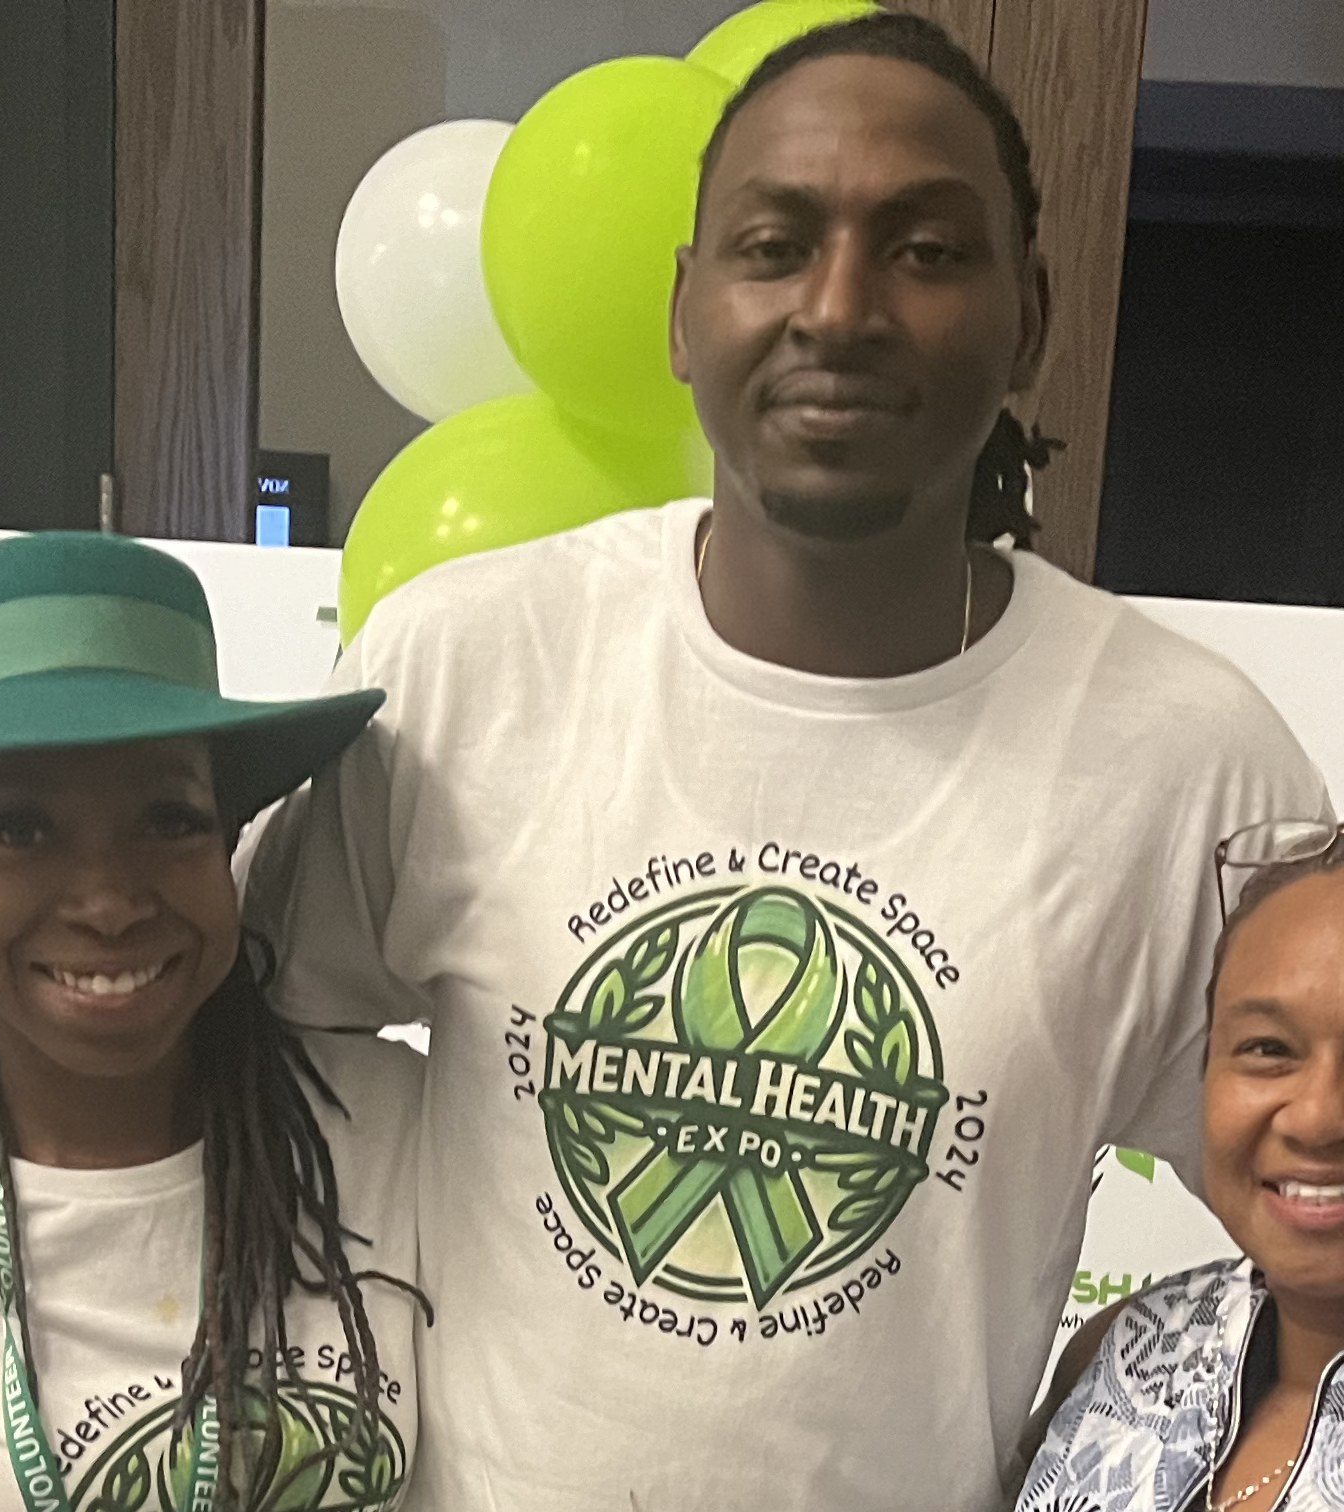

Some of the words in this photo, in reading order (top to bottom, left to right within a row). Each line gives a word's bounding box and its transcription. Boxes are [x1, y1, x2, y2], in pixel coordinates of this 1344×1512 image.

[567, 847, 716, 944] Redefine
[757, 842, 880, 904] Create
[881, 893, 960, 990] Space
[505, 1004, 537, 1100] 2024
[549, 1036, 743, 1109] MENTAL
[750, 1062, 928, 1155] HEALTH
[935, 1089, 988, 1193] 2024
[602, 1282, 719, 1348] Create
[758, 1247, 902, 1340] Redefine
